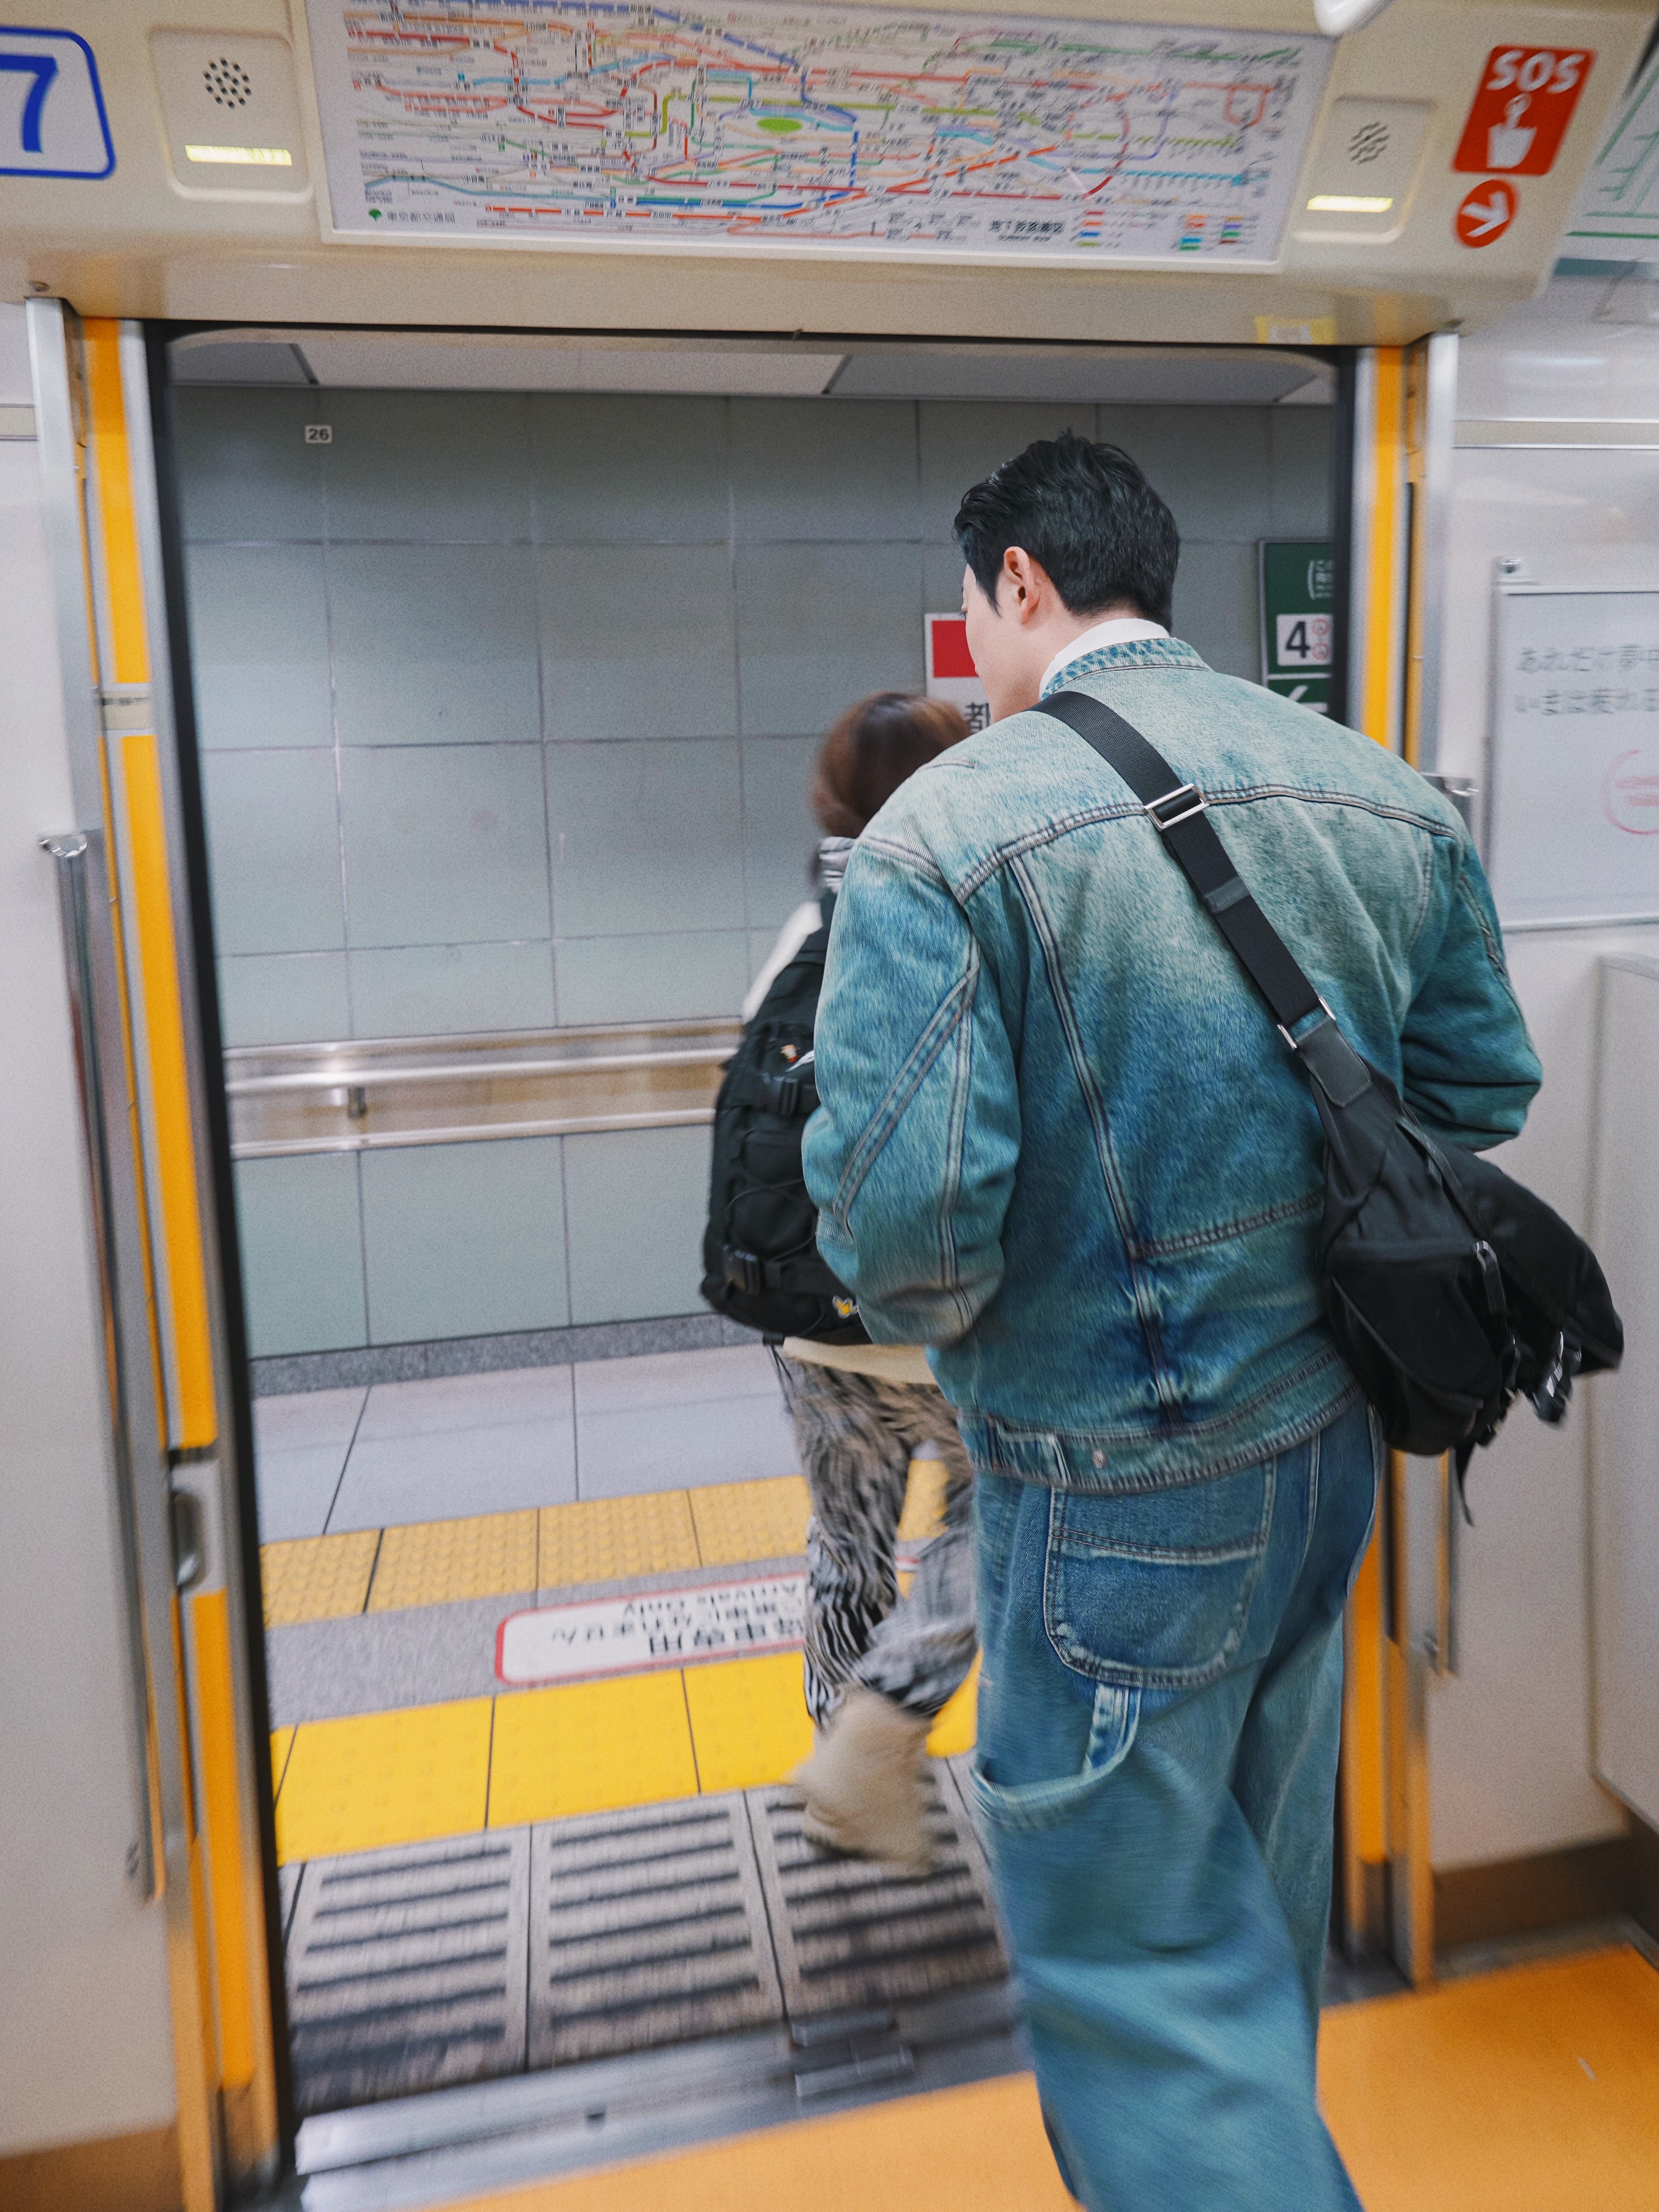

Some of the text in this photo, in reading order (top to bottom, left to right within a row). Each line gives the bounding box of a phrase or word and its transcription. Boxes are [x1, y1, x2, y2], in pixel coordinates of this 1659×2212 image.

[1486, 50, 1586, 93] SOS
[0, 53, 59, 154] 7
[308, 428, 329, 441] 26
[1285, 621, 1311, 658] 4
